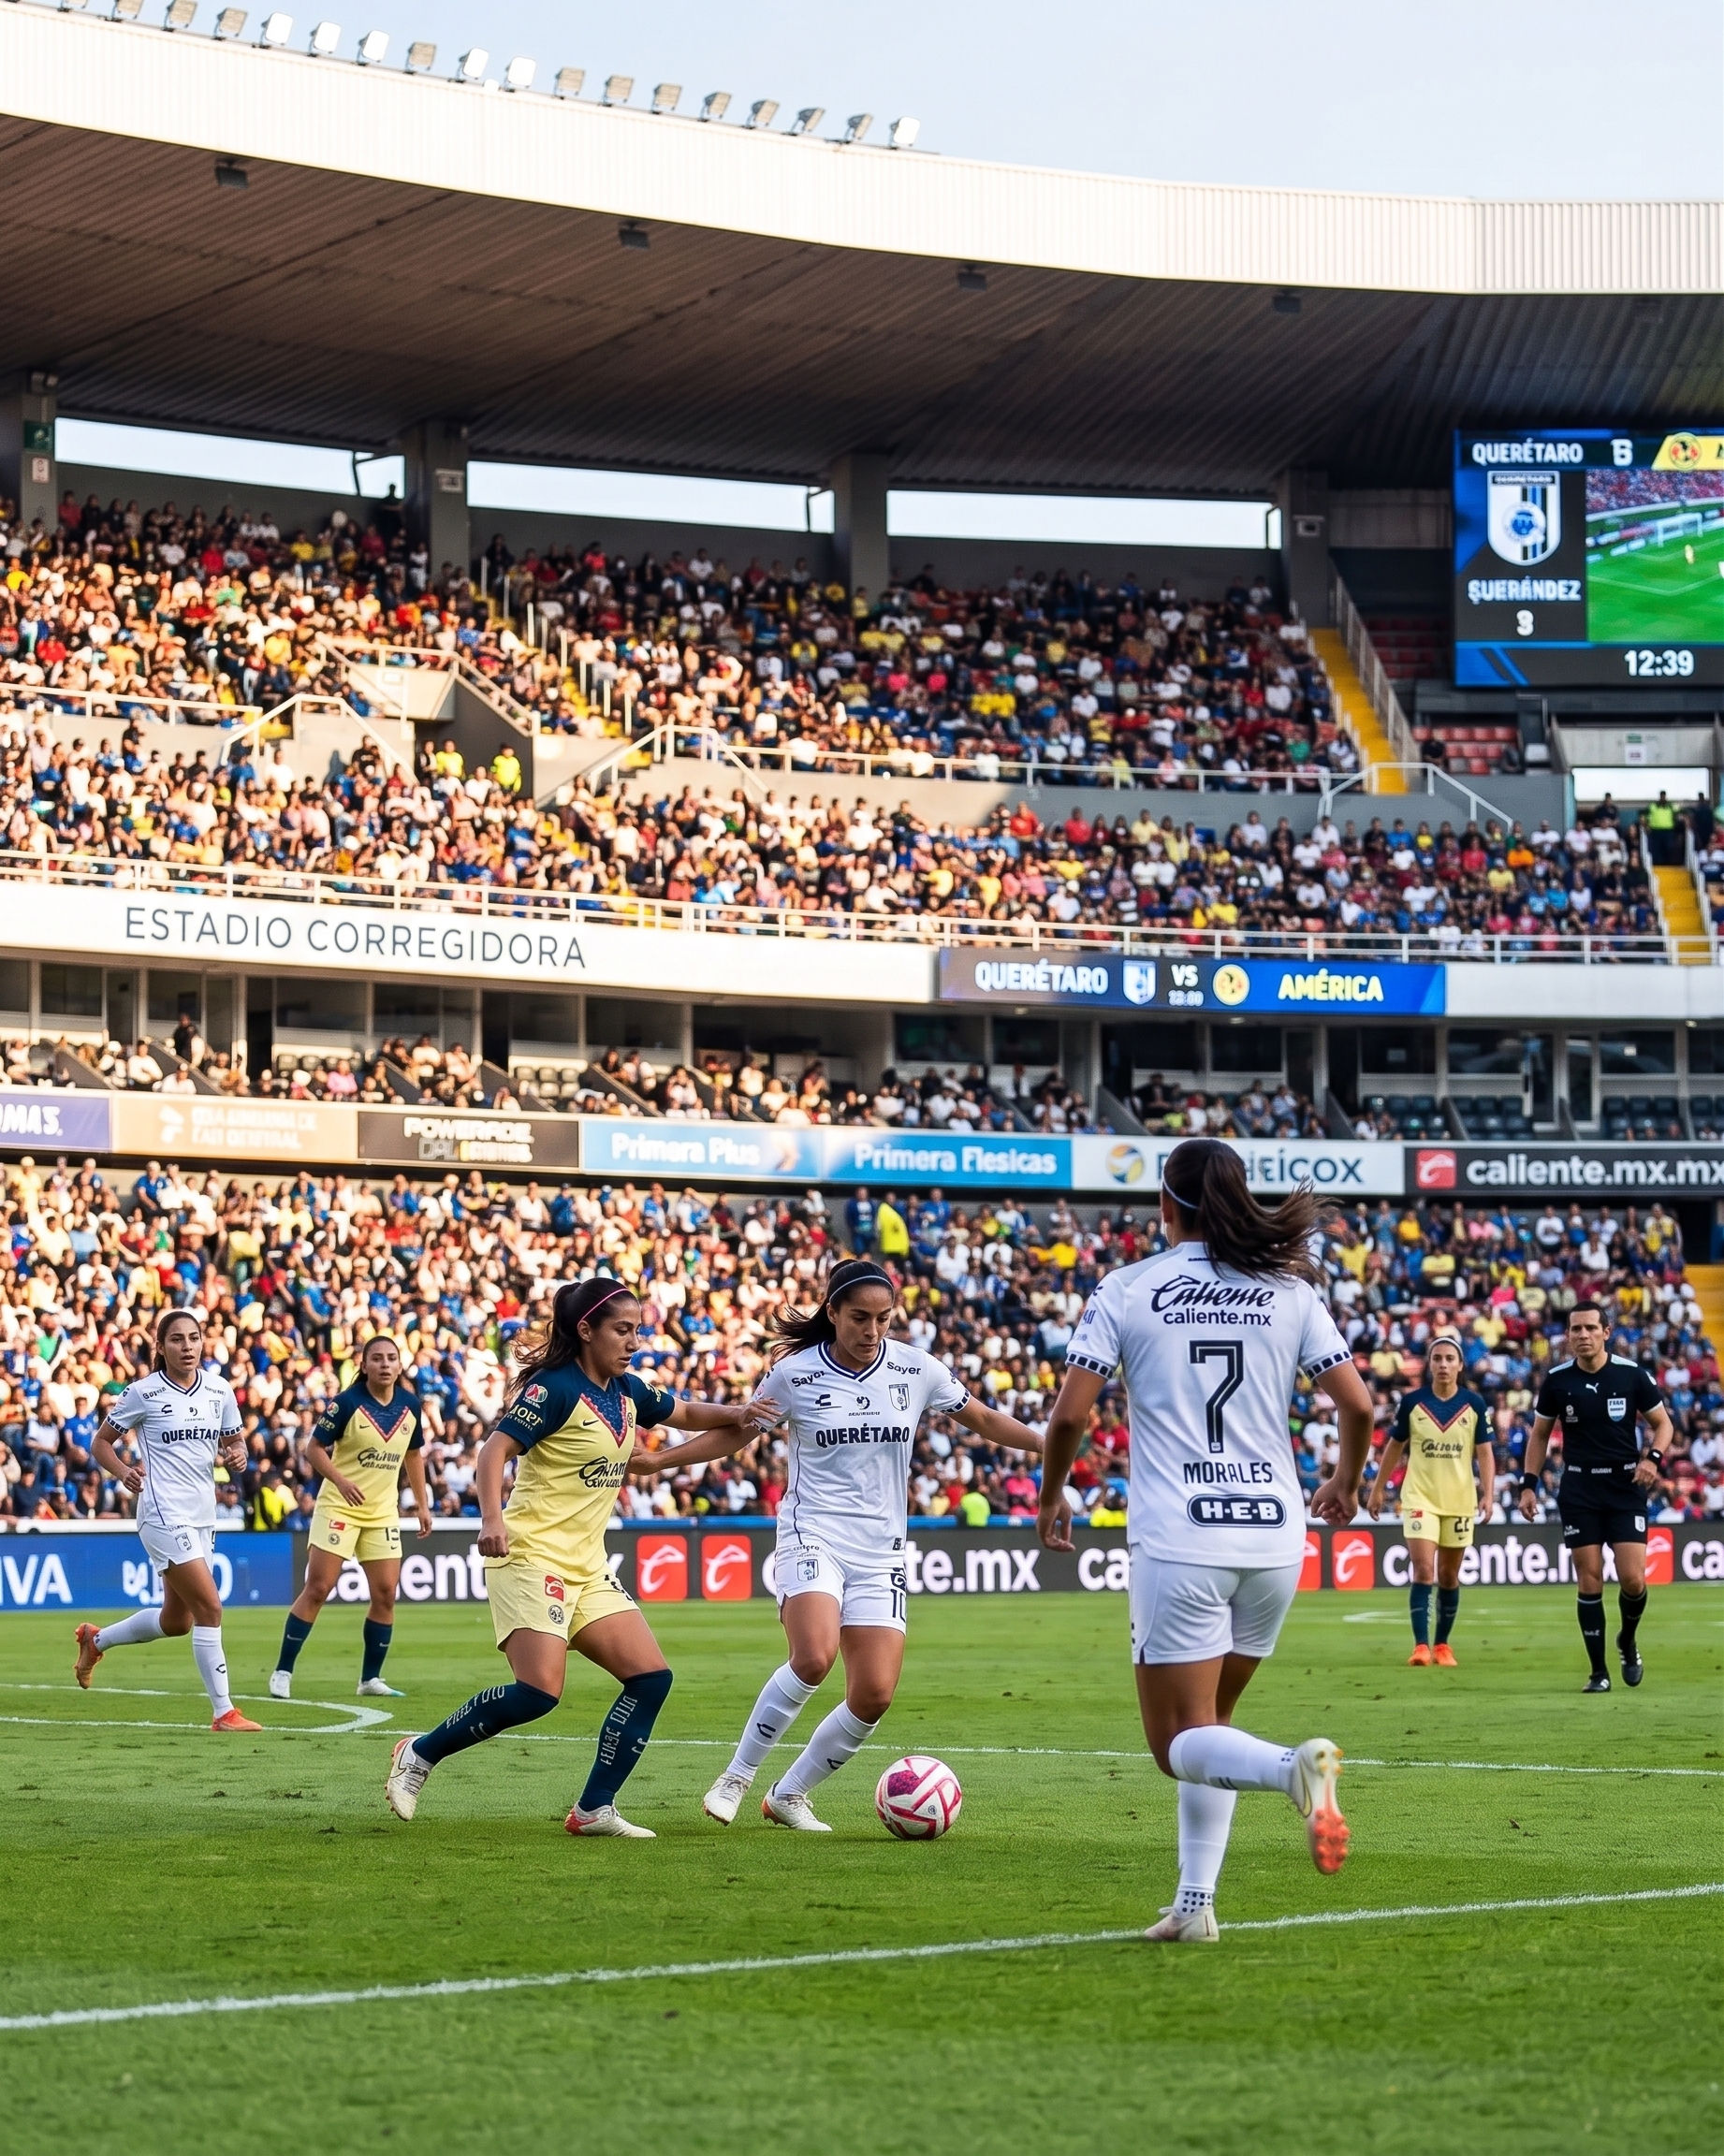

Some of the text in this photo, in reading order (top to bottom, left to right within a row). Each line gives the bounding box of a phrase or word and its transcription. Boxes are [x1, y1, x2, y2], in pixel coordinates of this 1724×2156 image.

[1472, 438, 1584, 465] QUERÉTARO
[1625, 649, 1694, 677] 12:39
[125, 906, 586, 969] ESTADIO CORREGIDORA
[974, 958, 1108, 994] QUERÉTARO
[1171, 964, 1199, 987] VS
[1278, 968, 1385, 1002] AMÉRICA
[855, 1143, 957, 1172] Primera
[1163, 1307, 1272, 1326] caliente.mx
[886, 1361, 921, 1375] Sayer
[1190, 1340, 1244, 1453] 7
[816, 1422, 910, 1449] QUERÉTARO
[1183, 1462, 1273, 1484] MORALES
